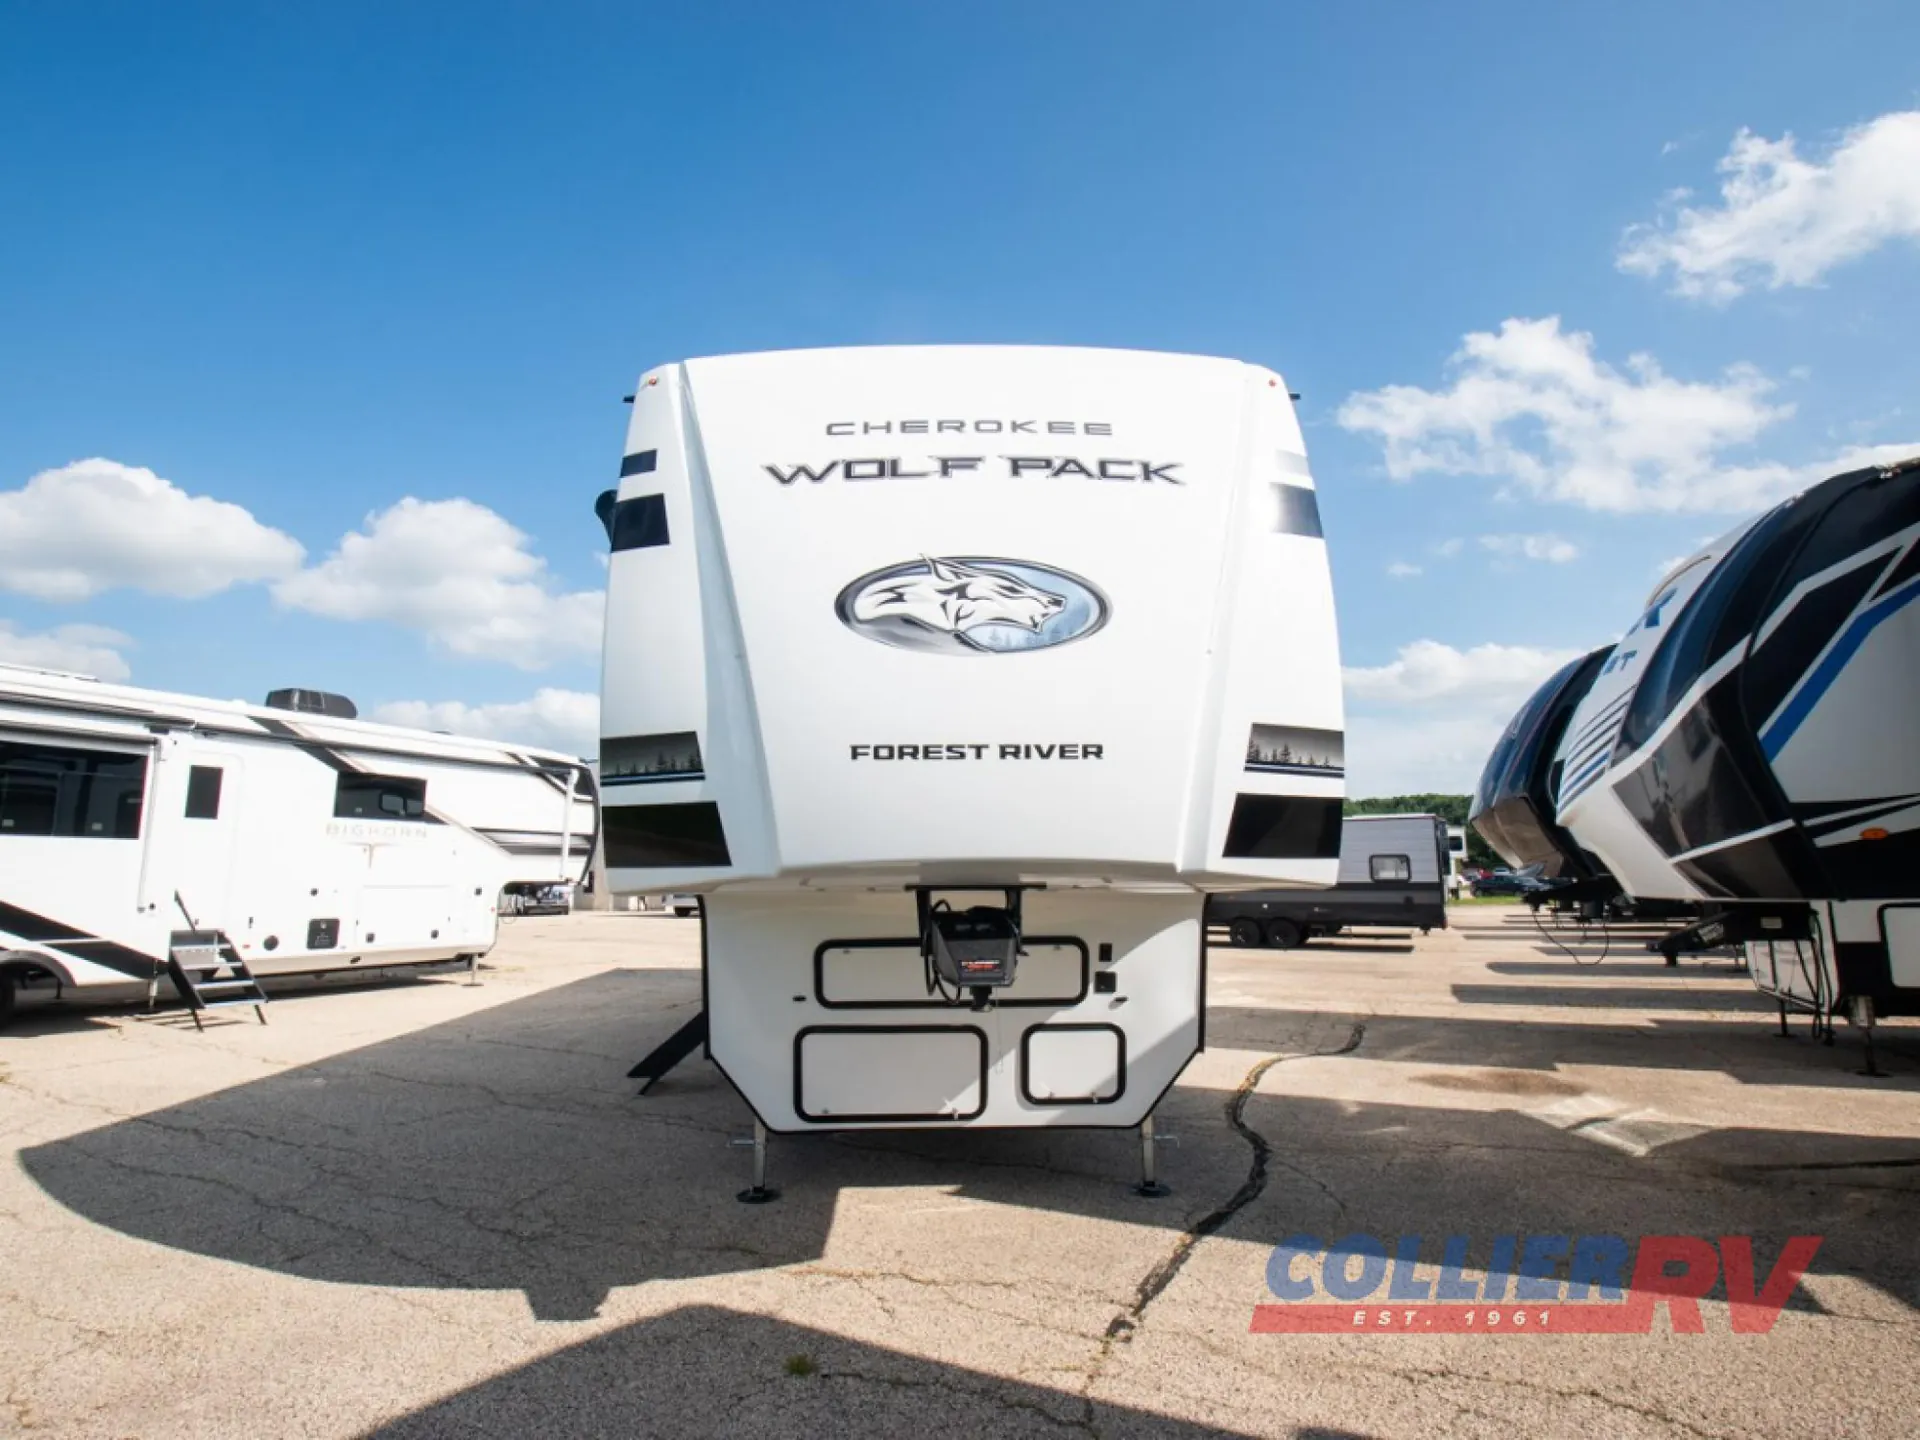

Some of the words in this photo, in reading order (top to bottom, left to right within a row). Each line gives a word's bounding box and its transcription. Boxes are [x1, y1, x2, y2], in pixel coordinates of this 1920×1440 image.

[825, 419, 1113, 436] CHEROKEE
[760, 456, 985, 487] WOLF
[997, 455, 1187, 487] PACK
[850, 744, 989, 760] FOREST
[999, 744, 1104, 760] RIVER
